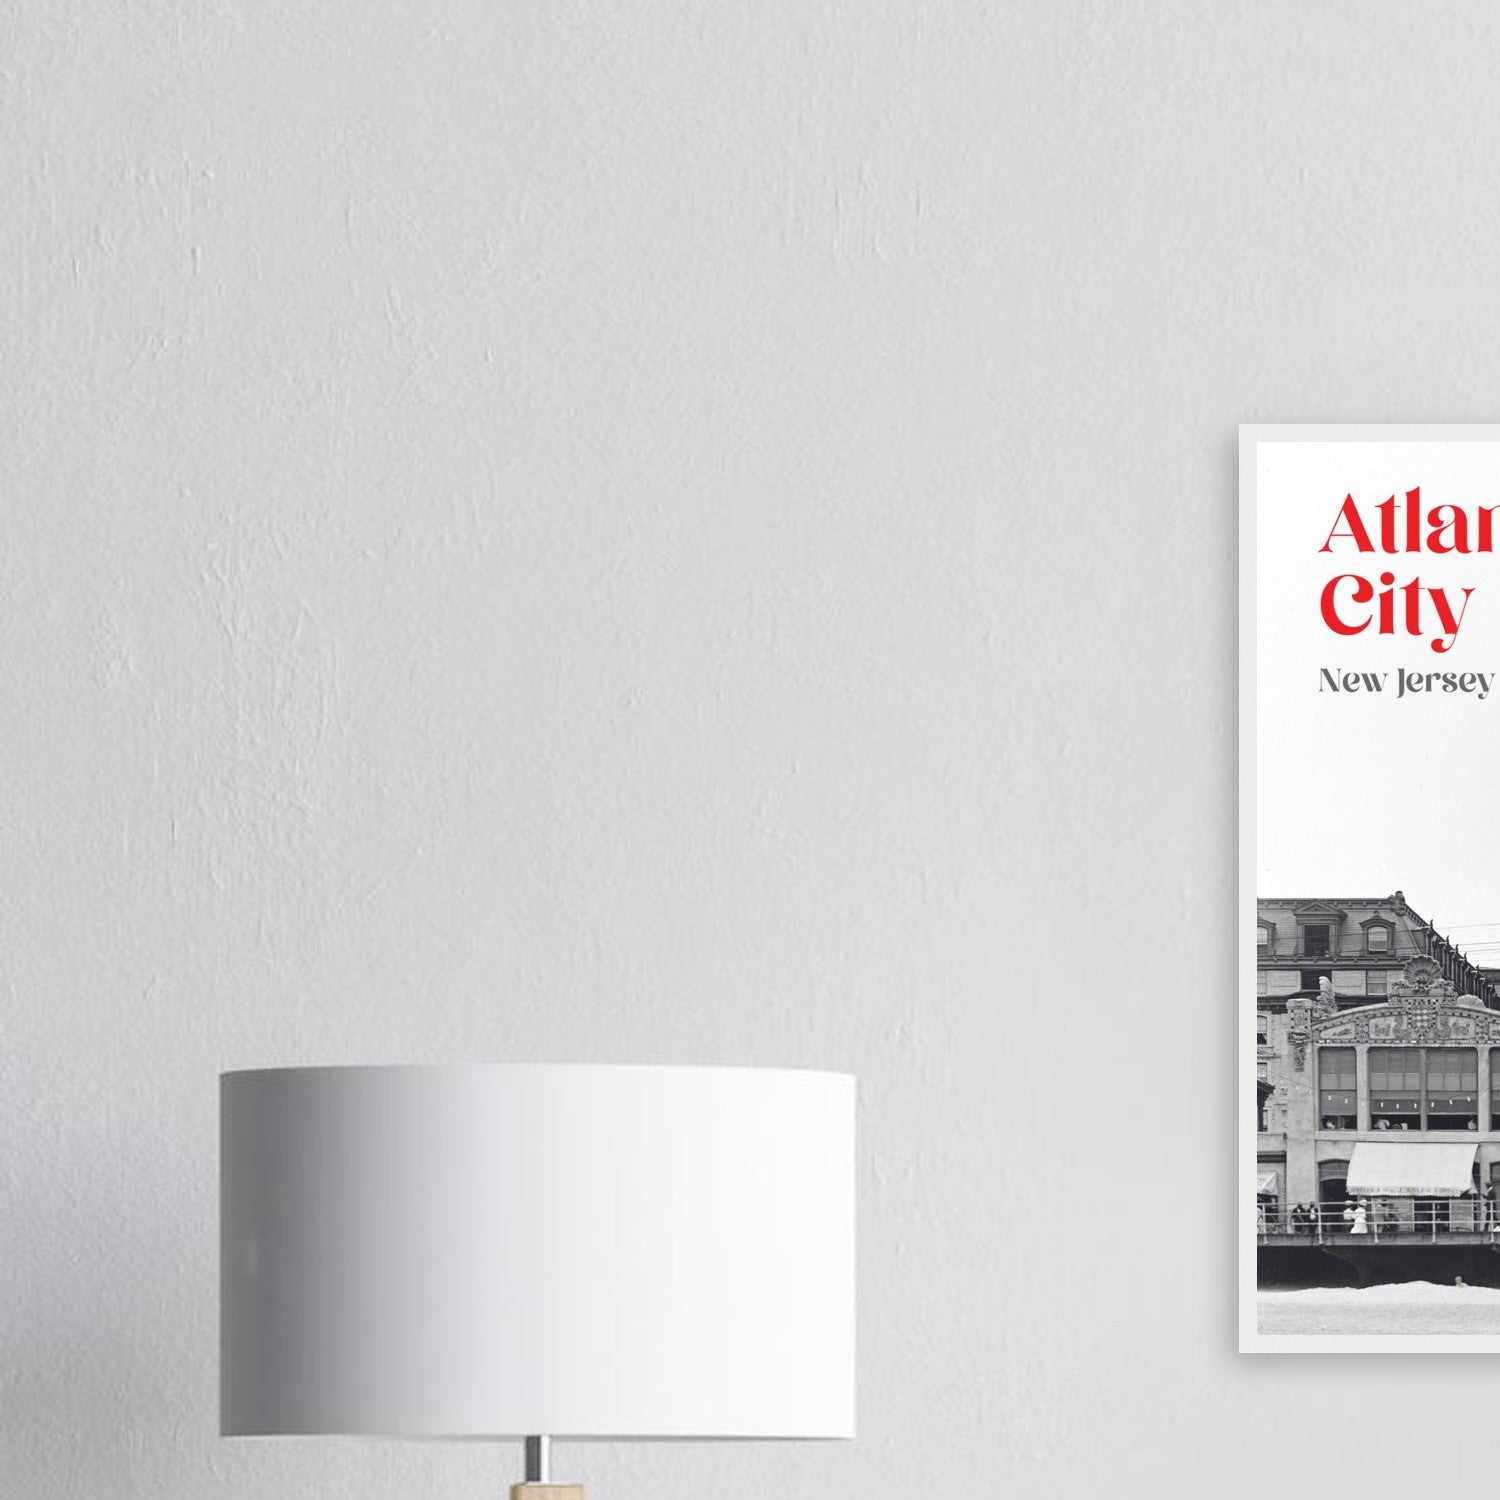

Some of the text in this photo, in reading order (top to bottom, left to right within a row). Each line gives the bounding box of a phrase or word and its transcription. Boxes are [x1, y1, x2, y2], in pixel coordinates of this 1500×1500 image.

[1320, 571, 1476, 654] City
[1319, 668, 1495, 700] New Jersey
